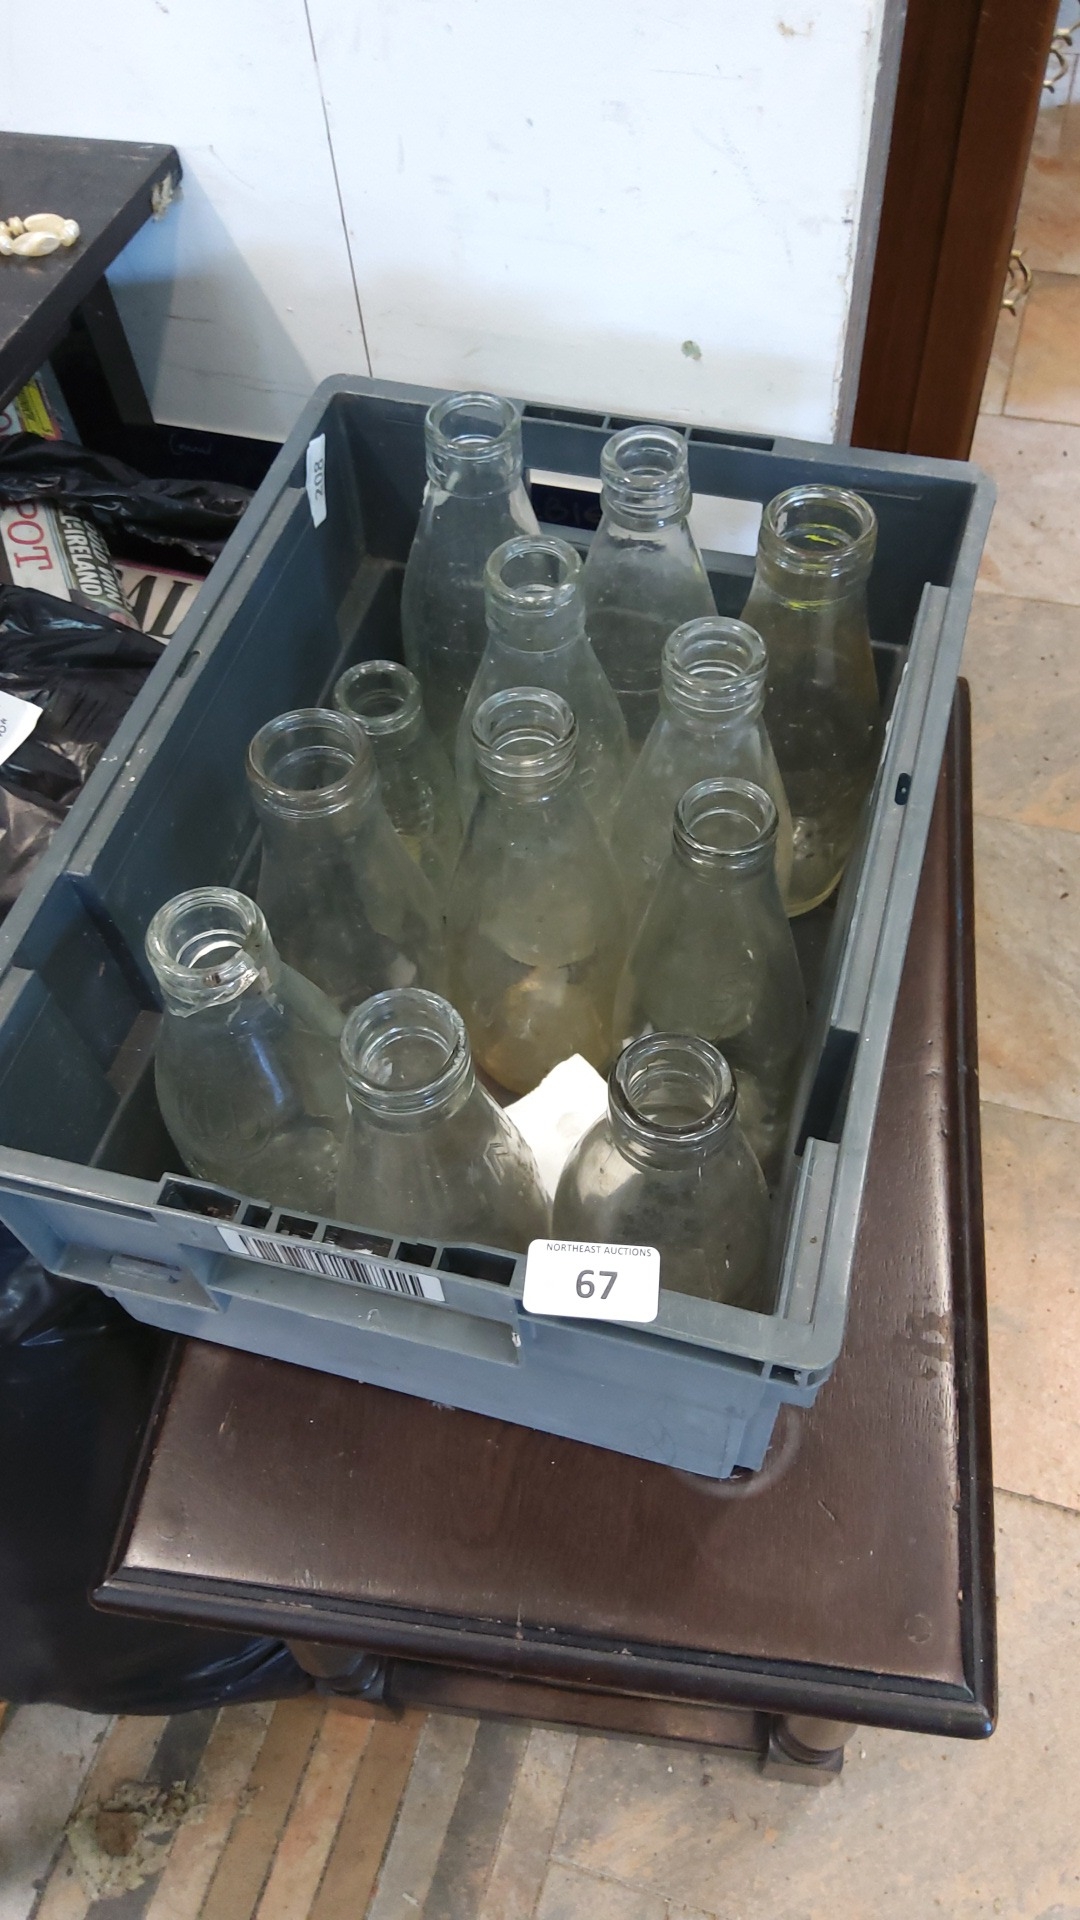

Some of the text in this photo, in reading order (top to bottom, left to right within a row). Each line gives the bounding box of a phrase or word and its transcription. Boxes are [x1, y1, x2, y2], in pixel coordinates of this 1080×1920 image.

[60, 511, 103, 596] L-IRELAND
[97, 564, 123, 605] WIN
[546, 1243, 652, 1257] NORTHEAST AUCTIONS
[575, 1269, 618, 1300] 67
